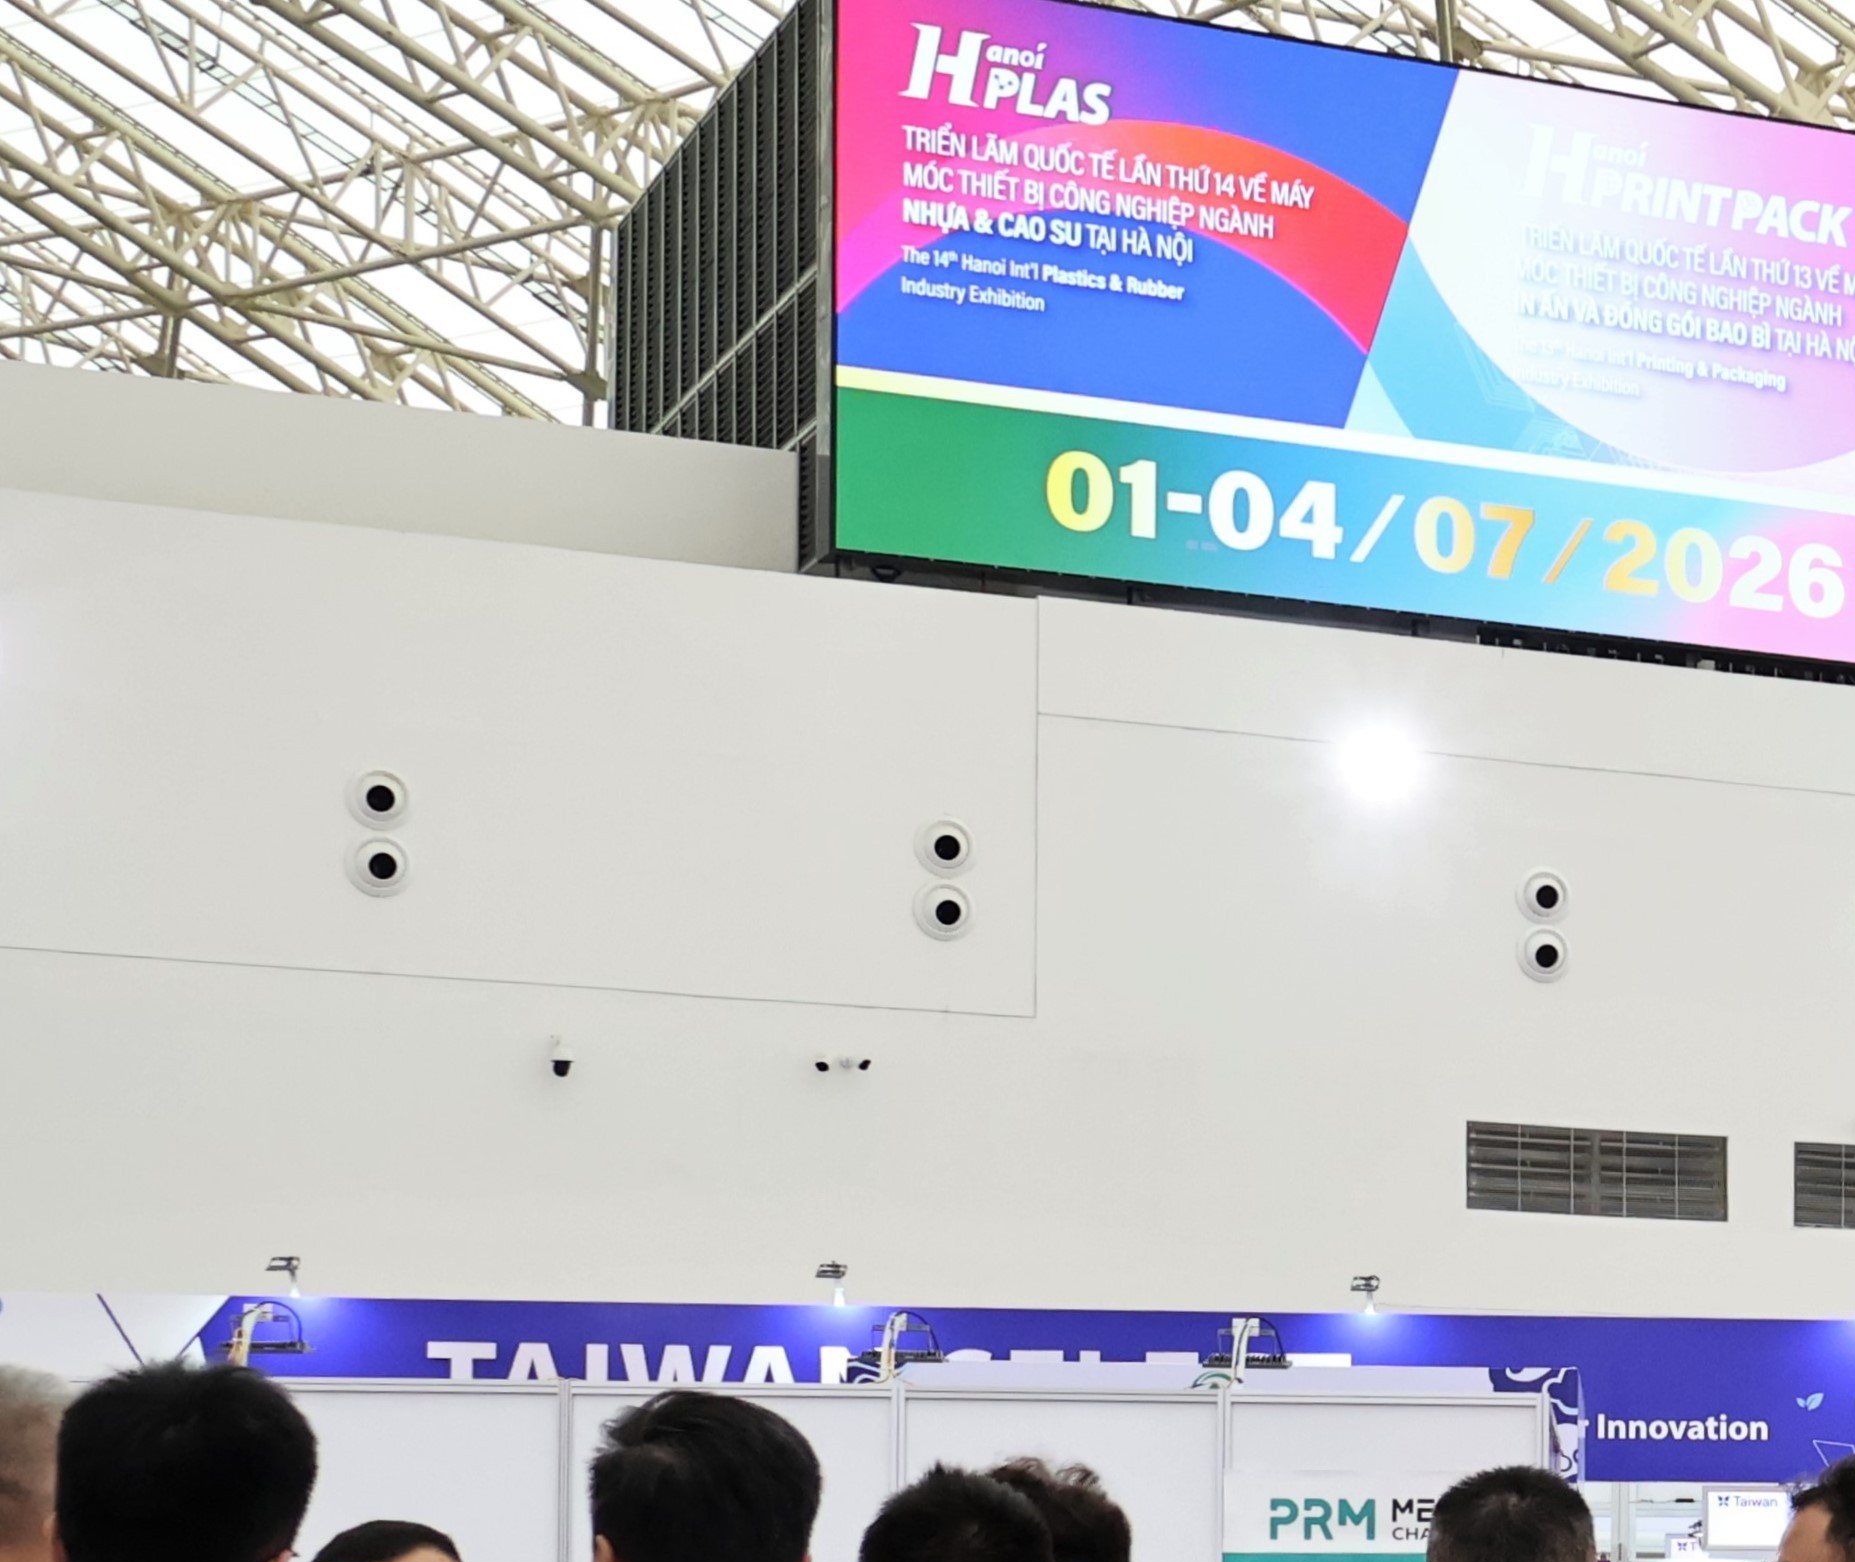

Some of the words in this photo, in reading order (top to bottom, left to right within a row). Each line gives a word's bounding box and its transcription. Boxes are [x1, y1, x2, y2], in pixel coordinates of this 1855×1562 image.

[984, 68, 1112, 125] PLAS
[902, 123, 965, 158] TRIỂN
[971, 134, 1018, 165] LÃM
[1024, 142, 1084, 176] QUỐC
[1089, 151, 1118, 179] TẾ
[1119, 153, 1161, 187] LẦN
[1167, 162, 1212, 194] THỨ
[1214, 172, 1235, 198] 14
[1239, 173, 1268, 202] VỀ
[1271, 182, 1314, 209] MÁY
[903, 198, 969, 233] NHỰA
[974, 212, 993, 235] &
[998, 212, 1045, 241] CAO
[1050, 219, 1082, 248] SU
[1085, 223, 1117, 255] TẠI
[1122, 227, 1150, 260] HÀ
[1157, 232, 1193, 266] NỘI
[1591, 168, 1853, 248] PRINTPACK
[901, 245, 930, 266] The
[932, 249, 958, 269] 14th
[962, 252, 1005, 276] Hanoi
[1042, 265, 1105, 290] Plastics
[1109, 272, 1123, 292] &
[1127, 276, 1184, 301] Rubber
[901, 276, 965, 304] Industry
[970, 285, 1044, 312] Exhibition
[1597, 1414, 1769, 1441] Innovation
[1270, 1498, 1375, 1540] PRM
[1734, 1496, 1778, 1507] Taiwan
